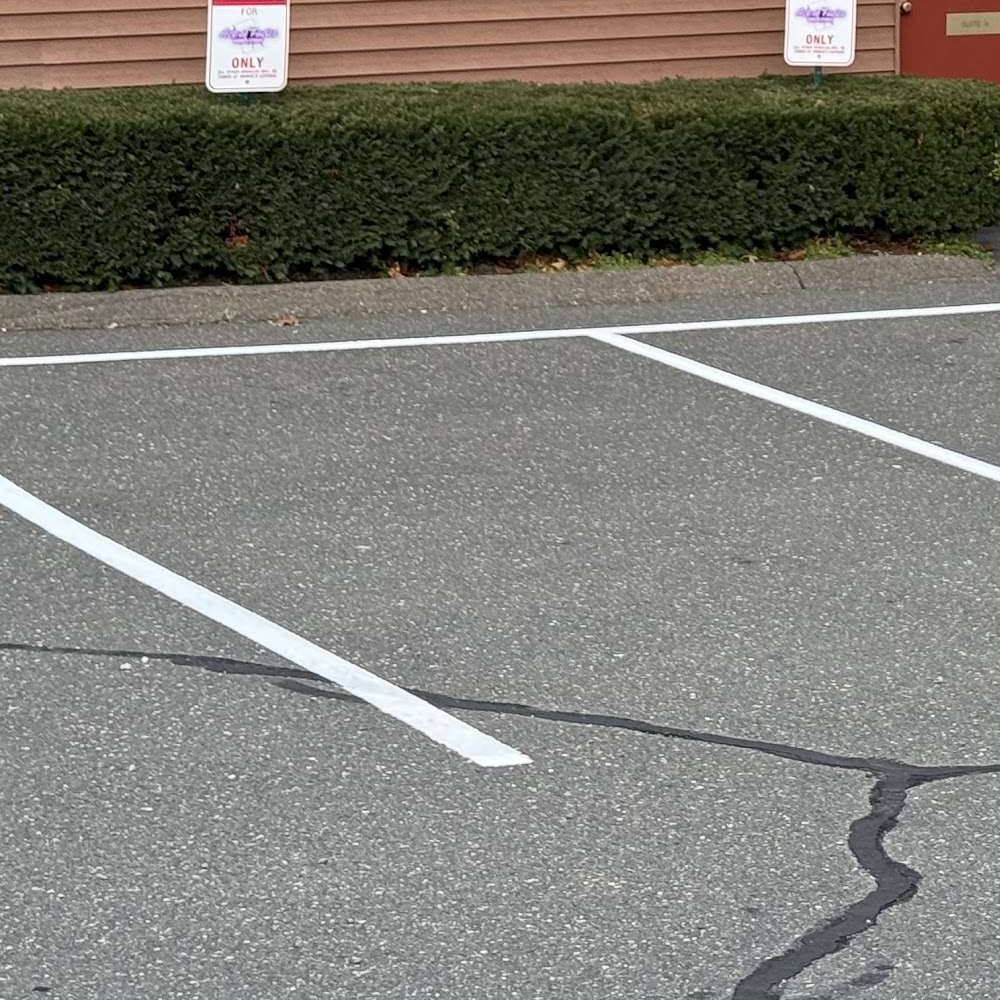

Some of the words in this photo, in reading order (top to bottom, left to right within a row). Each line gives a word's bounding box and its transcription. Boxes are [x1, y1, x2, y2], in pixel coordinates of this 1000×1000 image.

[241, 7, 257, 16] FOR
[806, 34, 834, 45] ONLY
[232, 57, 264, 69] ONLY
